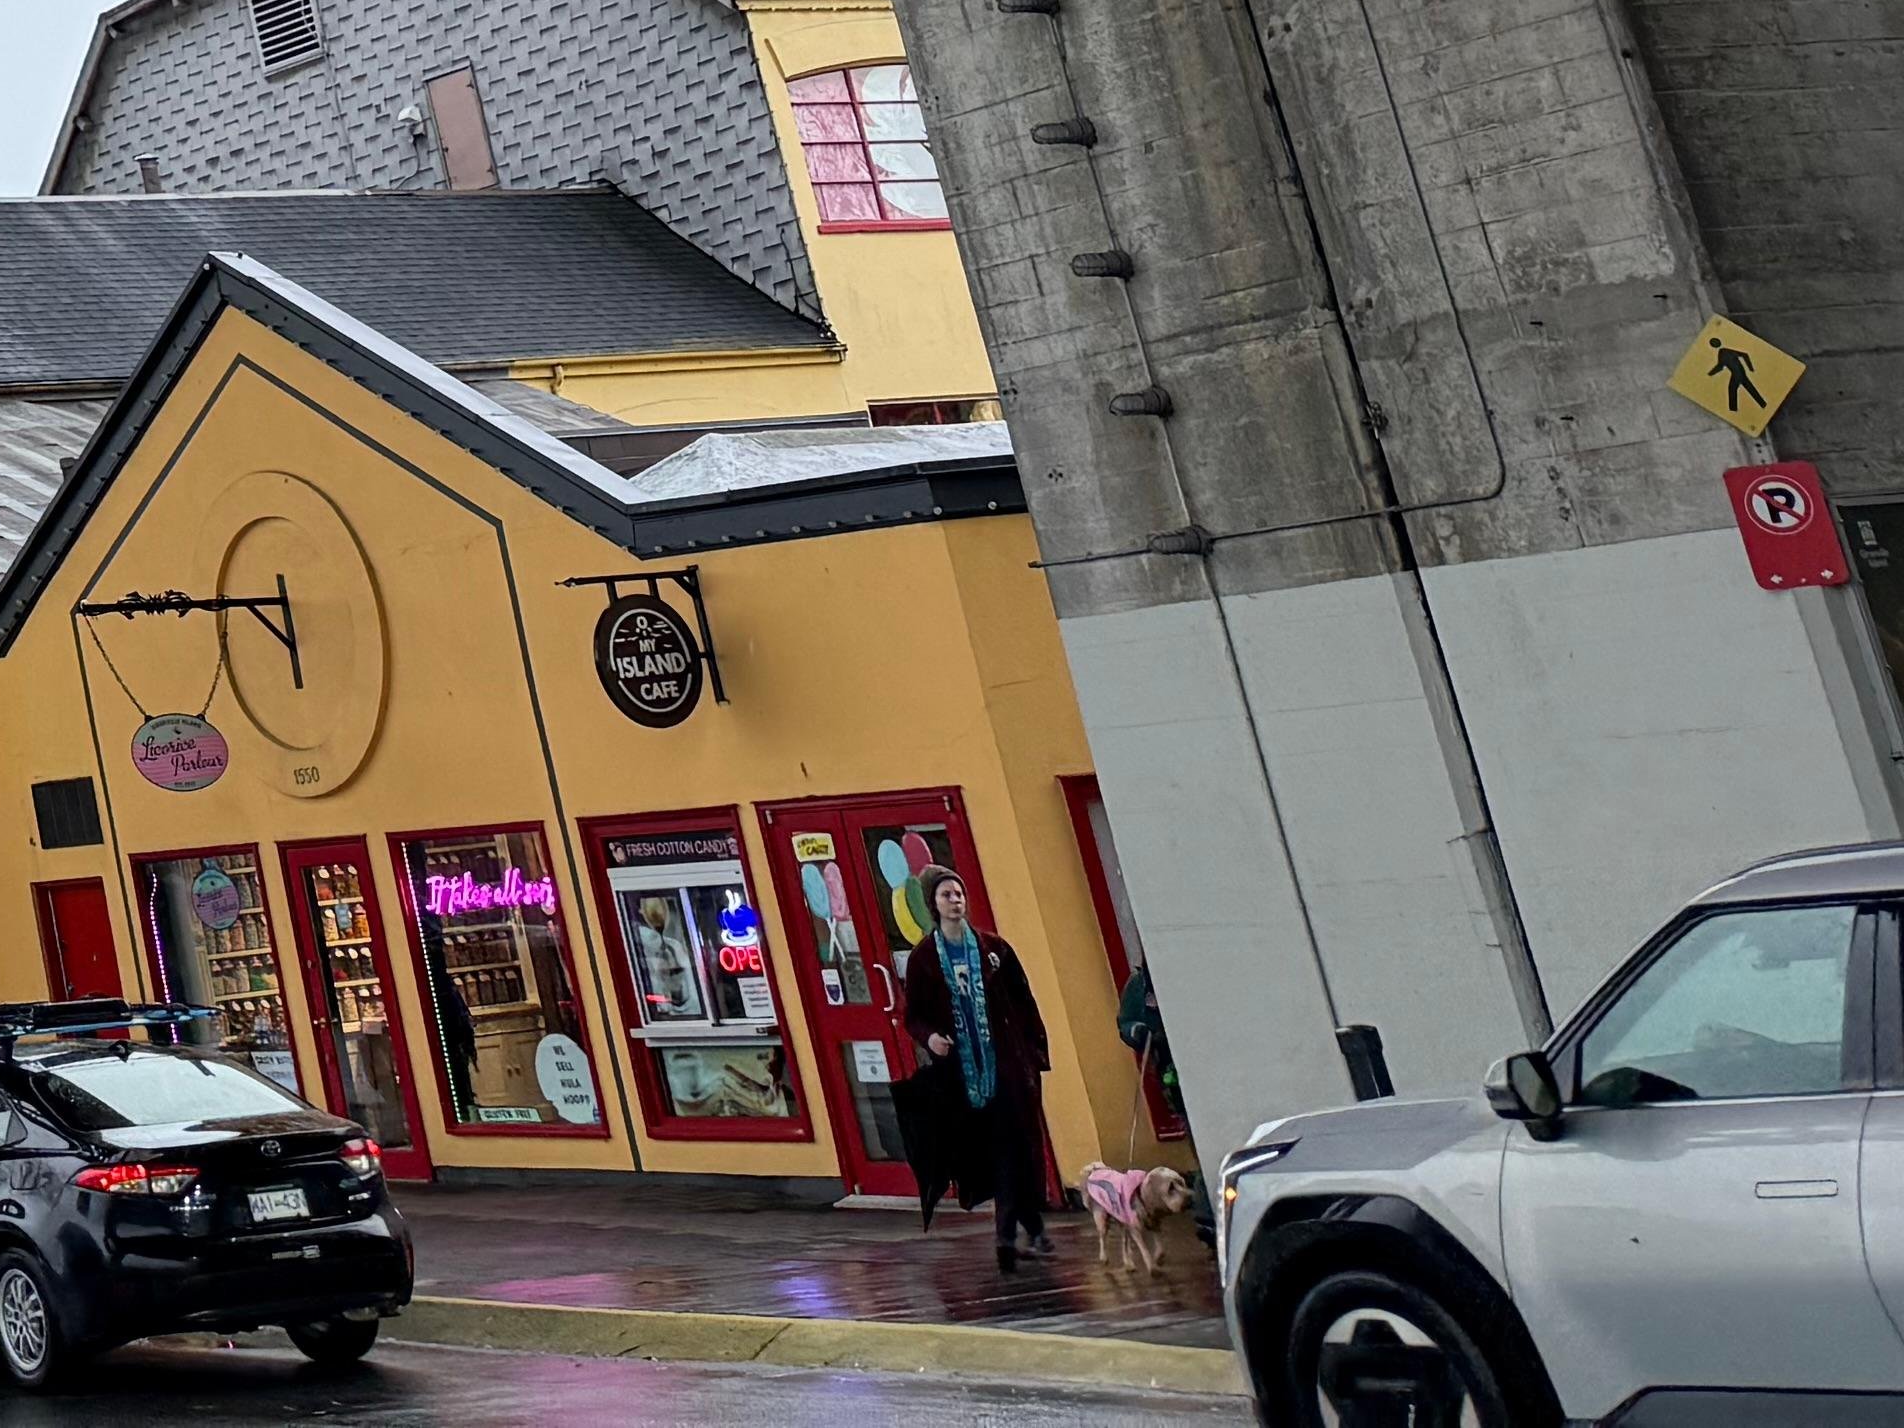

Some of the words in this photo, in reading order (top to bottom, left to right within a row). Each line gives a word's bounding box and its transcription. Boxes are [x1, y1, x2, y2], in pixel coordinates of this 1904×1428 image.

[639, 639, 656, 652] MY
[616, 652, 686, 679] ISLAND
[140, 736, 196, 762] Licorice
[171, 749, 223, 777] Parlour
[293, 766, 320, 785] 1550
[626, 843, 657, 856] FRESH
[657, 841, 694, 855] COTTON
[695, 839, 728, 854] CANDY
[719, 946, 762, 972] OPE
